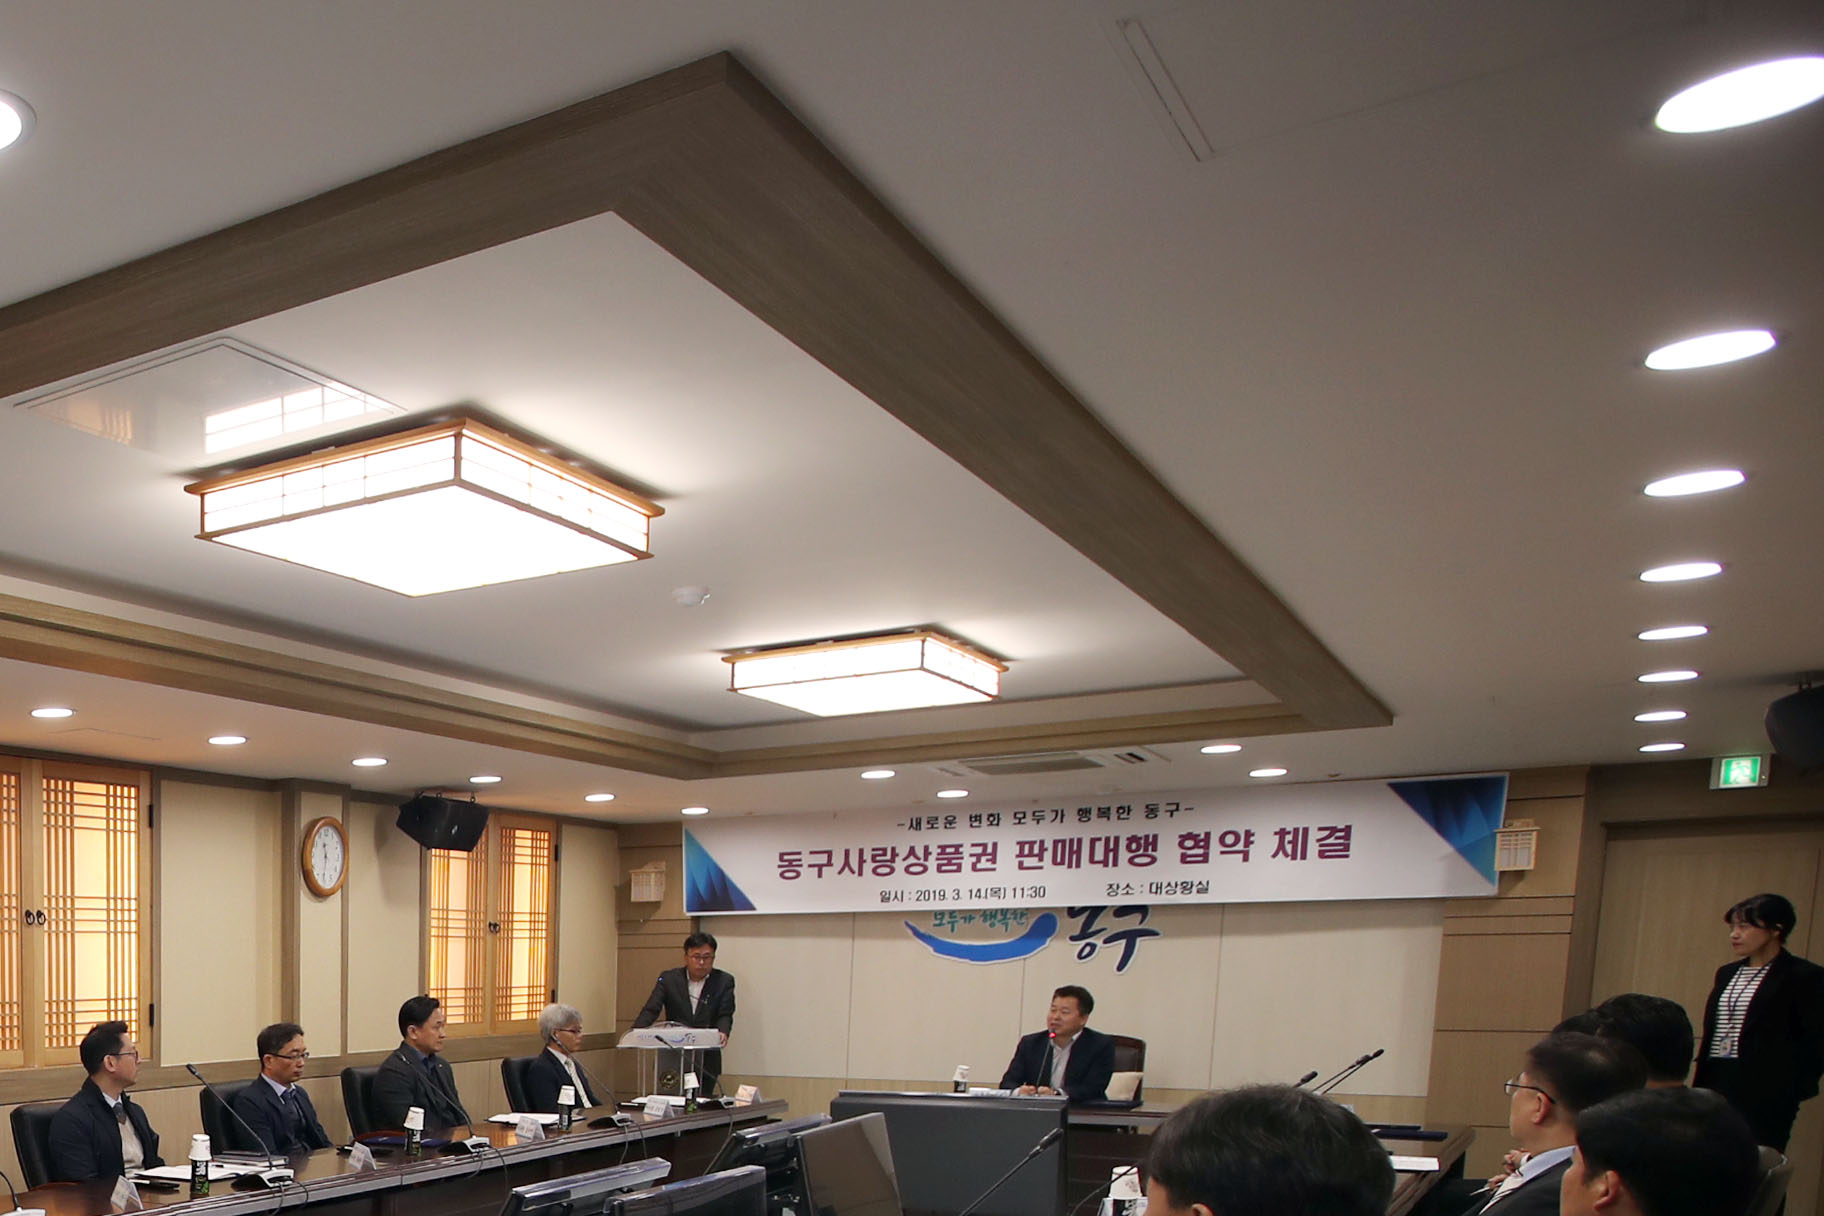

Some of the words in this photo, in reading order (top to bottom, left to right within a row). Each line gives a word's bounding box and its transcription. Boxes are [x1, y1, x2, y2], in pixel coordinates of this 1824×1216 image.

[969, 812, 1001, 828] 변화
[1013, 808, 1065, 825] 모두가
[1076, 804, 1132, 822] 행복한
[777, 841, 999, 880] 동구사랑상품권
[1014, 833, 1159, 871] 판매대행
[1177, 829, 1256, 865] 협약
[1271, 824, 1353, 861] 체결
[879, 889, 904, 903] 일시
[915, 888, 948, 902] 2019.
[1011, 885, 1047, 899] 11:30
[1106, 882, 1135, 897] 장소
[1148, 880, 1210, 896] 대상황실
[932, 910, 976, 933] 모두가
[979, 908, 1029, 932] 행복한
